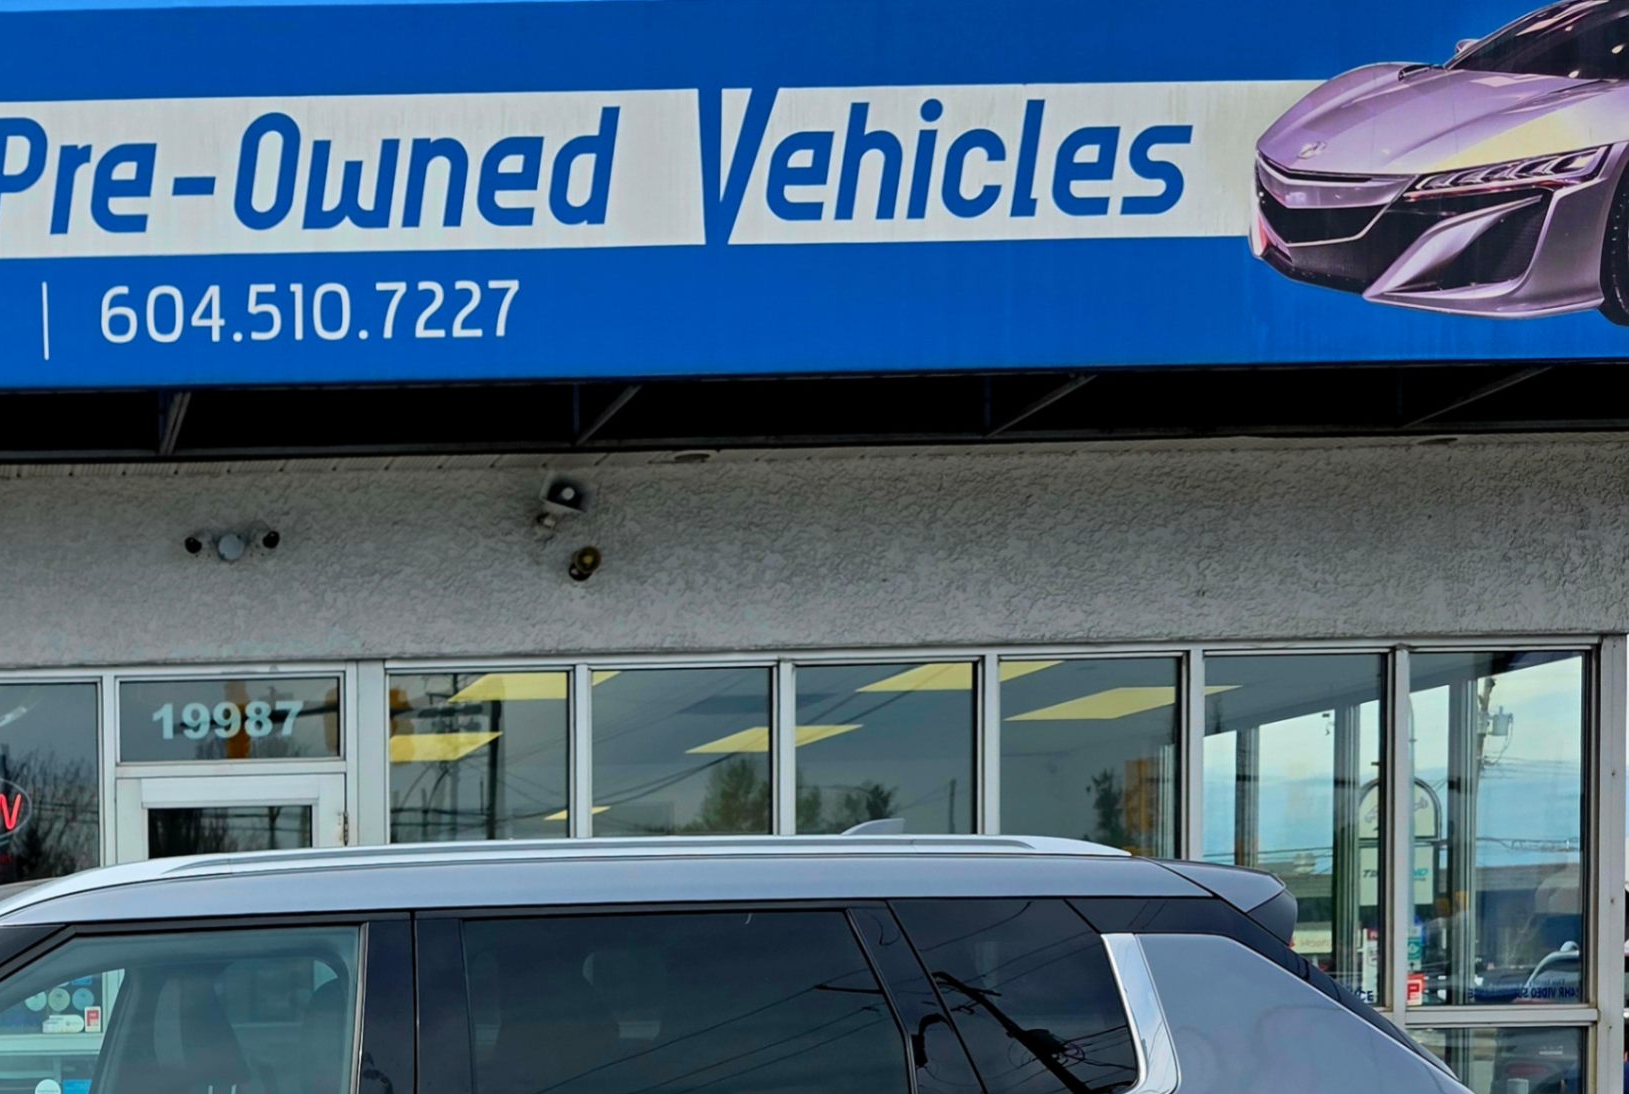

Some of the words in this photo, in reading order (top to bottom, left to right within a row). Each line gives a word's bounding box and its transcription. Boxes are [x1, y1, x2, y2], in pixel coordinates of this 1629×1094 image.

[698, 88, 1193, 246] Vehicles
[100, 280, 520, 343] 604.510.7227
[152, 700, 304, 740] 19987
